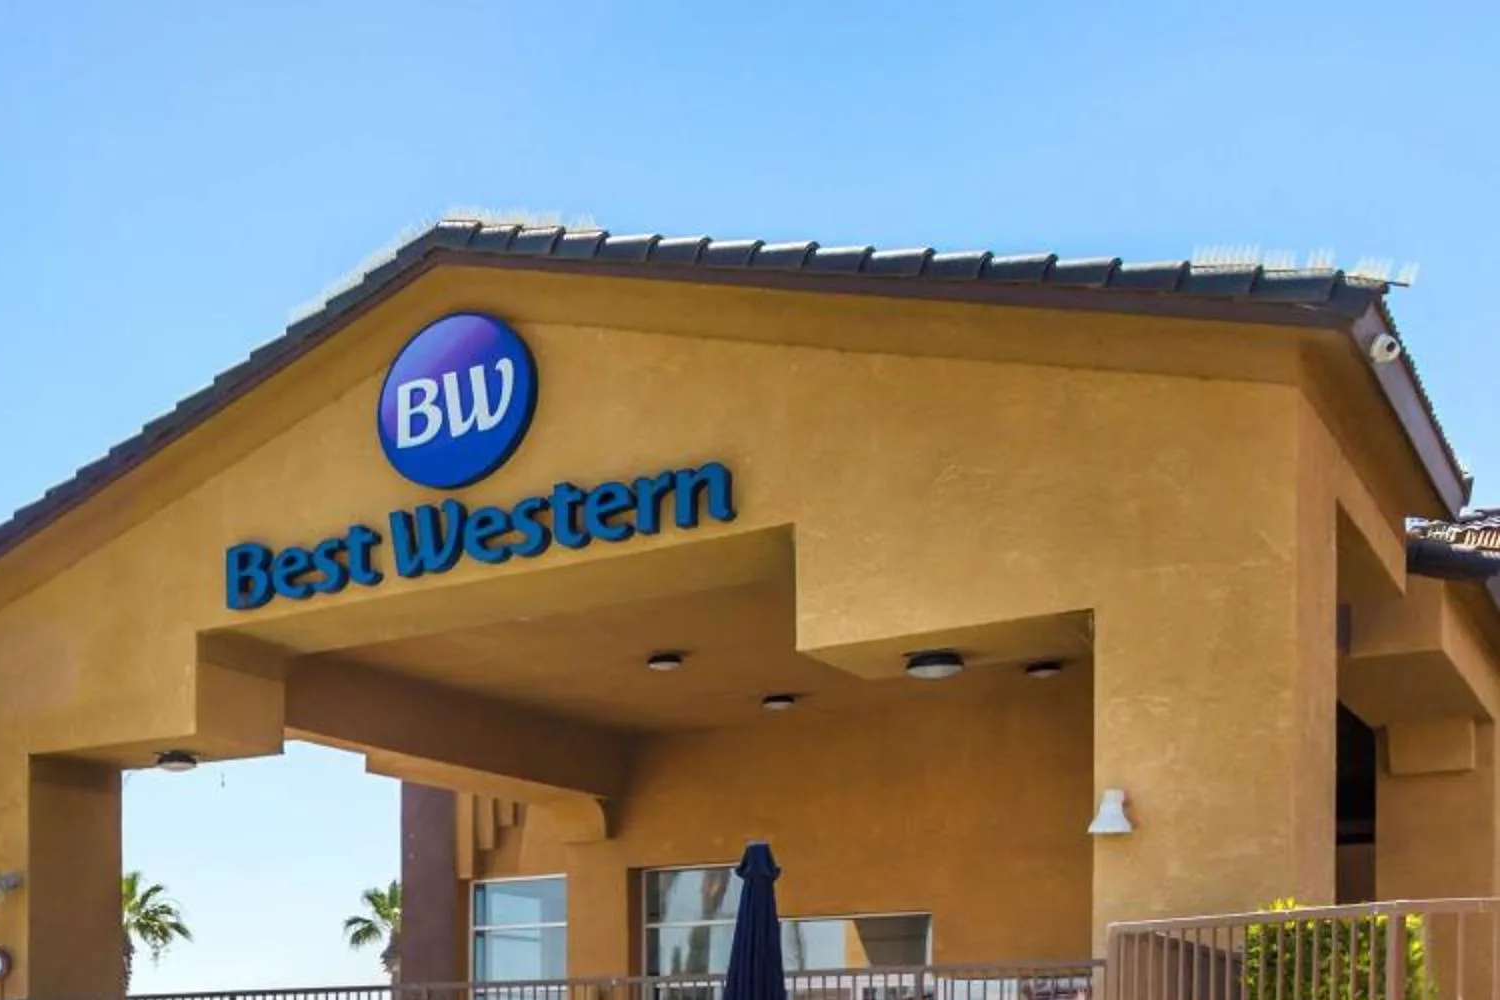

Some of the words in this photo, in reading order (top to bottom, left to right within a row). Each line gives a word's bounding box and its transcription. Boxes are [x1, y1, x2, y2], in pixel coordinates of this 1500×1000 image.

[397, 357, 514, 449] BW
[226, 524, 384, 611] Best
[389, 462, 737, 578] Western
